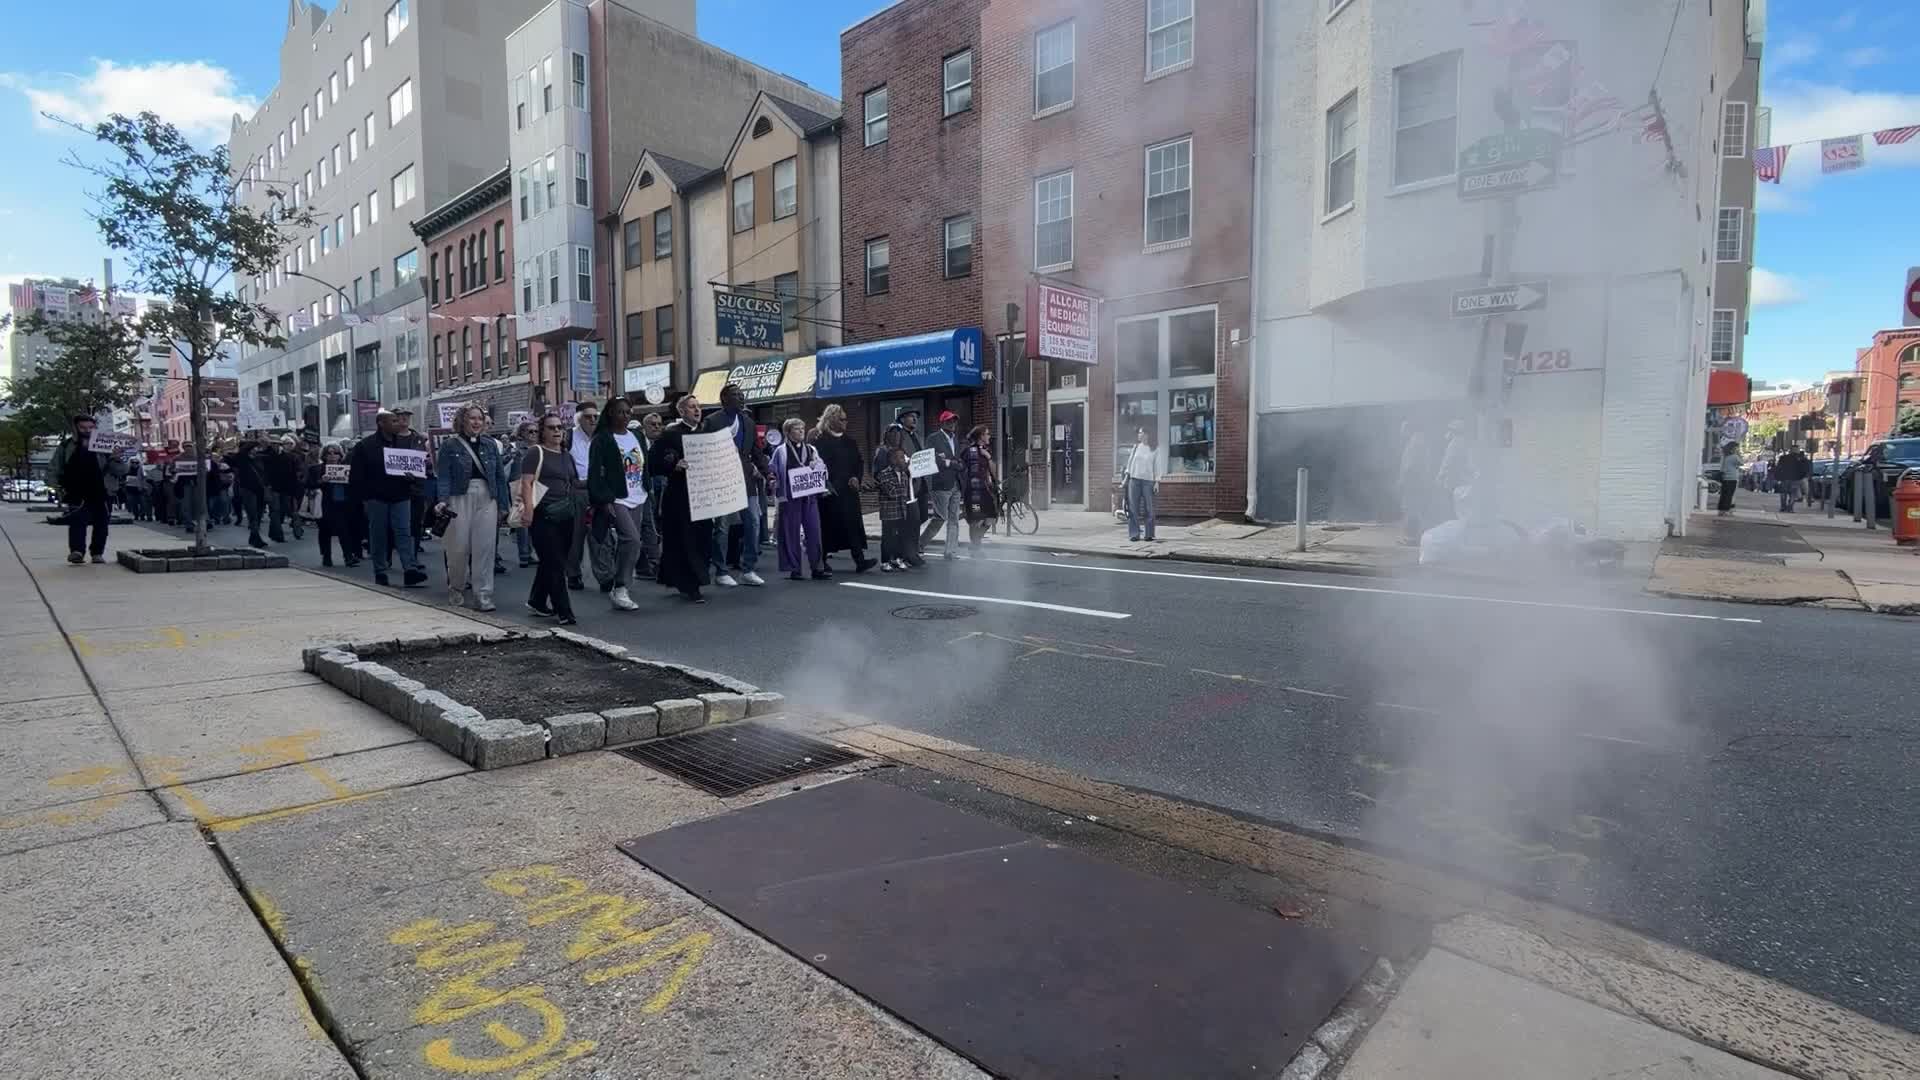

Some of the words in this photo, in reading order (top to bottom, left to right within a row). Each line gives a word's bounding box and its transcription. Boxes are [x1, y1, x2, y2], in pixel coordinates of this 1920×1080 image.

[1471, 174, 1497, 189] ONE
[1501, 168, 1528, 185] WAY
[717, 294, 781, 314] SUCCESS
[1049, 293, 1089, 312] ALLCARE
[1460, 295, 1488, 310] ONE
[1490, 293, 1517, 306] WAY
[1049, 307, 1088, 325] MEDICAL
[1047, 320, 1089, 338] EQUIPMENT
[888, 360, 913, 369] Gannon
[914, 355, 946, 366] Insurance
[834, 365, 876, 380] Nationwide
[893, 366, 929, 378] Associates,
[929, 364, 943, 375] Inc.
[387, 454, 409, 465] STAND
[1063, 424, 1073, 484] WELCOME
[793, 473, 809, 484] STAND
